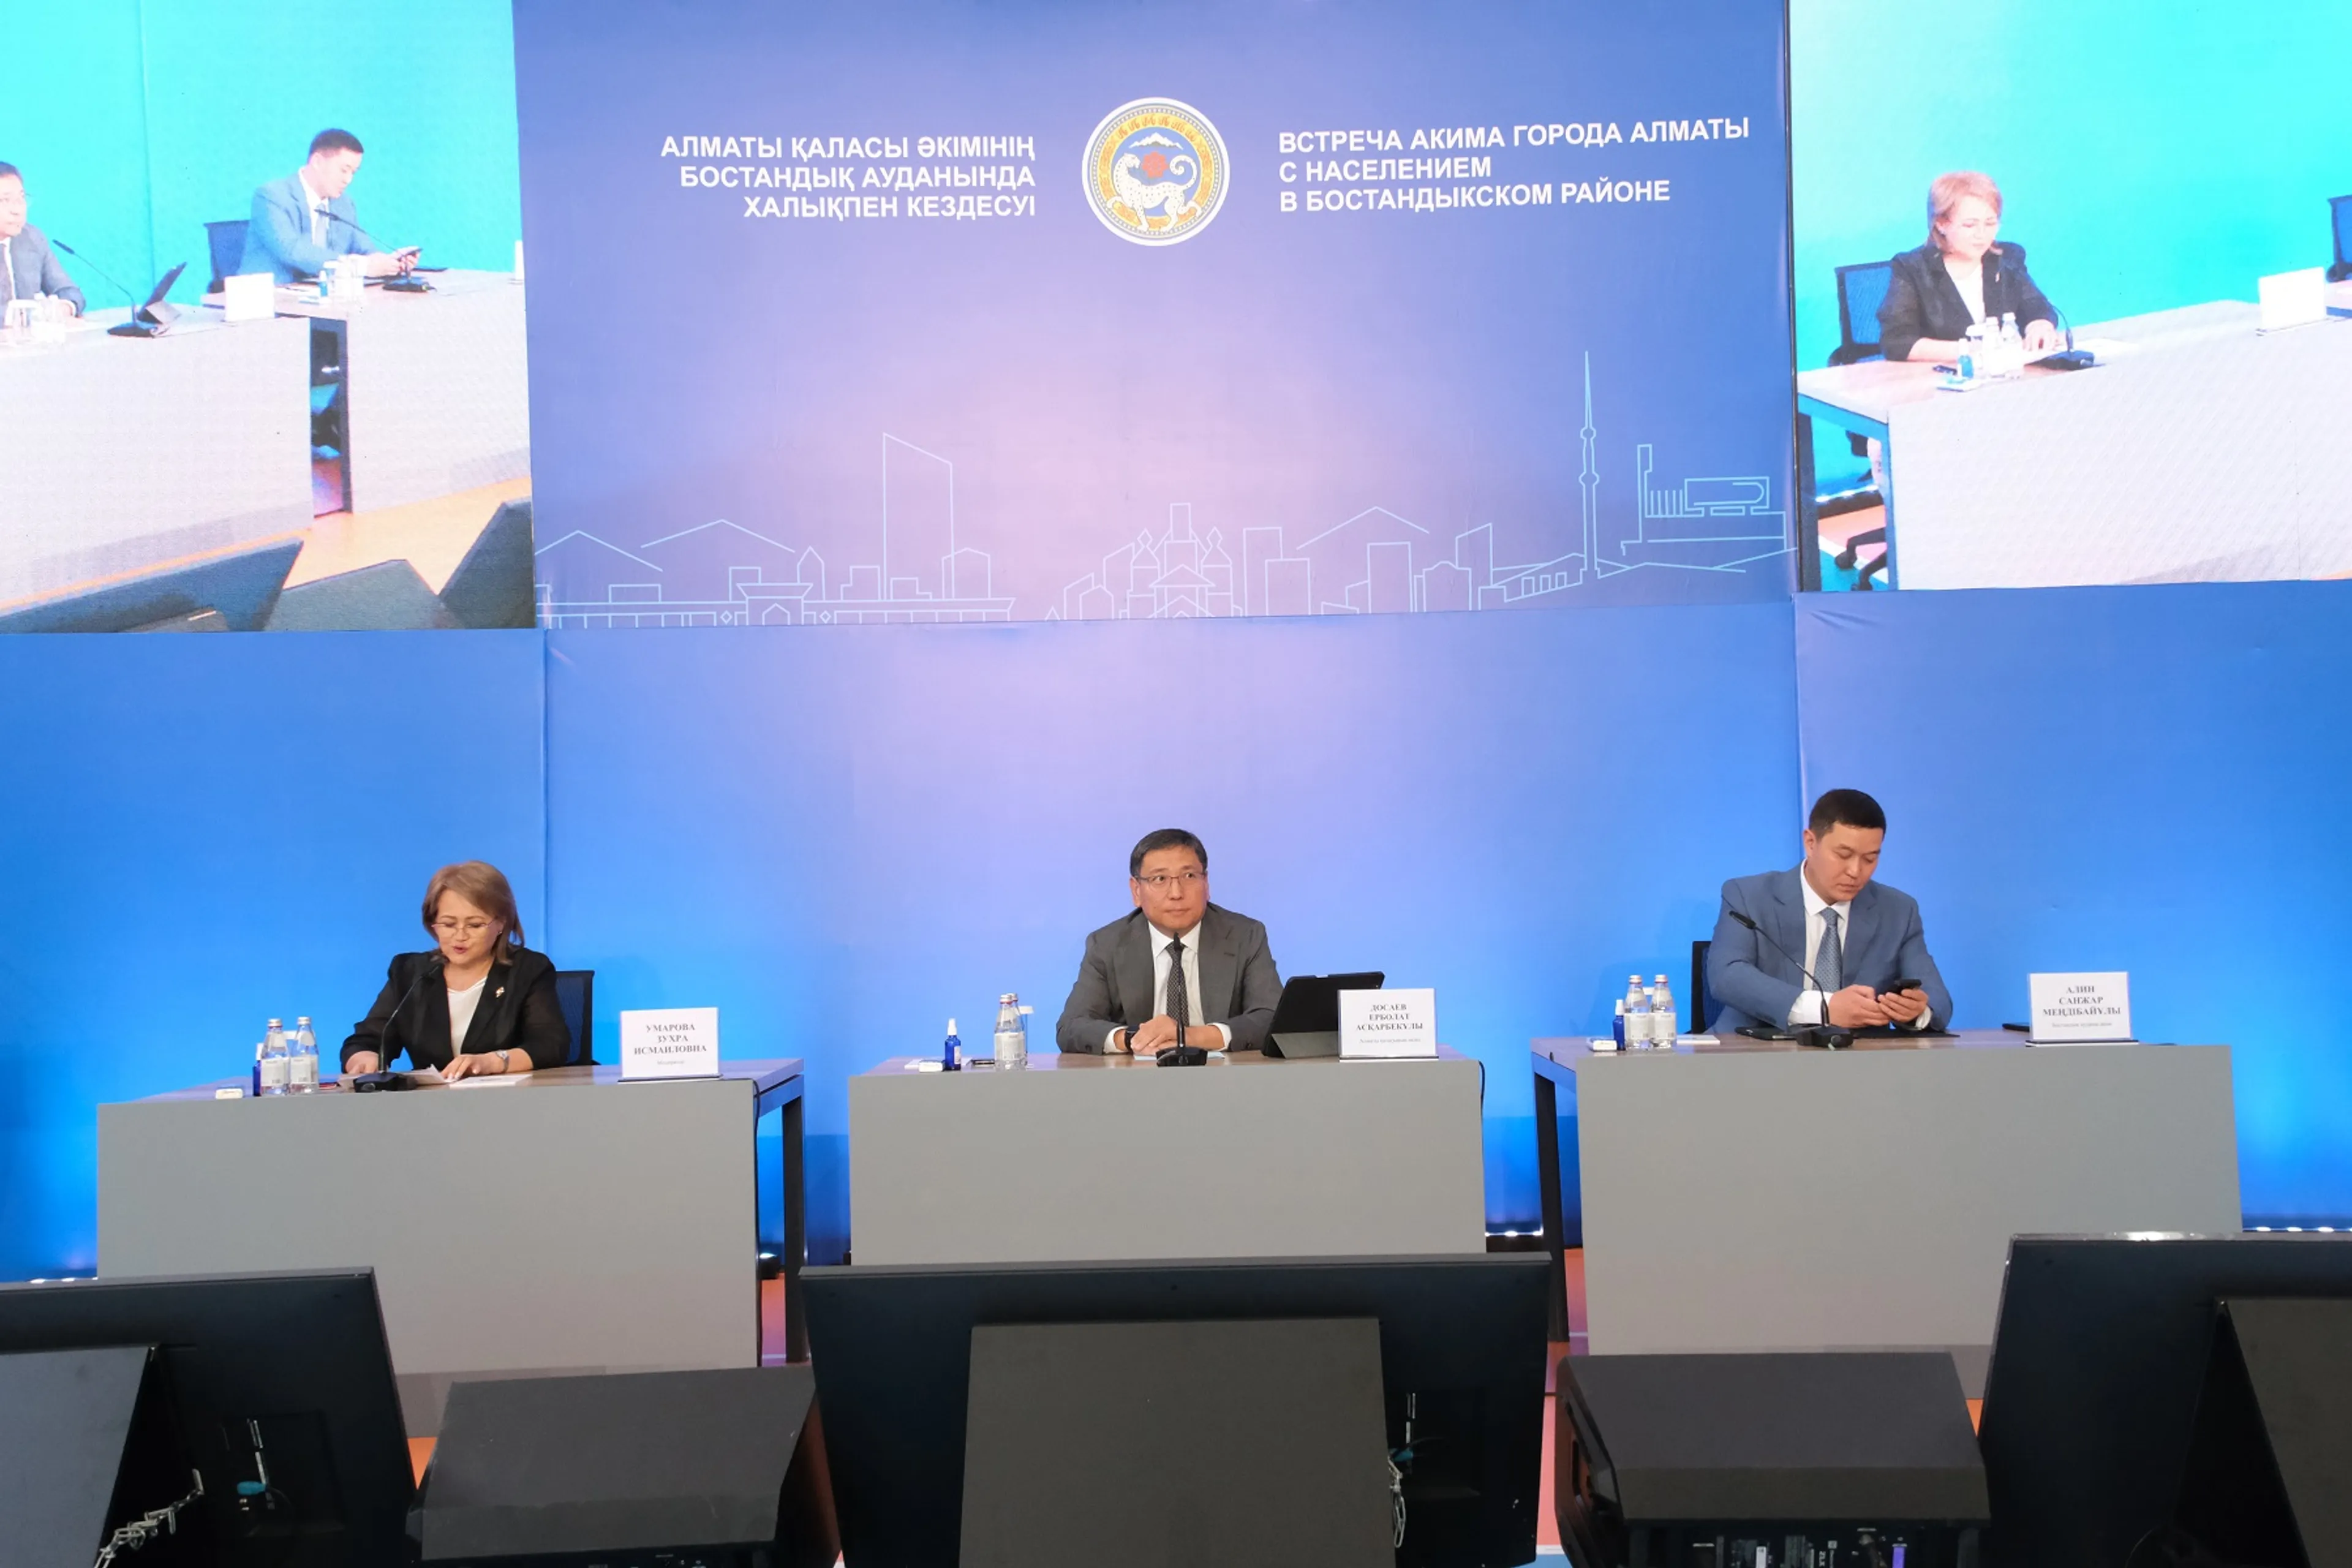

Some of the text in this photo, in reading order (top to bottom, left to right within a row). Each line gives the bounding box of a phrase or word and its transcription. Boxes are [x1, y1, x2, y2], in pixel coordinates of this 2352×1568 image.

[1280, 117, 1749, 153] ВСТРЕЧА АКИМА ГОРОДА АЛМАТЫ
[661, 136, 1035, 162] АЛМАТЫ ҚАЛАСЫ ӘКІМІНІҢ
[681, 166, 1035, 191] БОСТАНДЫҚ АУДАНЫНДА
[1280, 156, 1491, 182] С НАСЕЛЕНИЕМ
[1281, 176, 1670, 212] В БОСТАНДЫКСКОМ РАЙОНЕ
[744, 195, 1035, 221] ХАЛЫҚПЕН КЕЗДЕСУІ
[2059, 997, 2103, 1005] САНЖАР
[646, 1022, 695, 1033] УМАРОВА
[658, 1035, 688, 1044] ЗУХРА
[633, 1045, 707, 1055] ИСМАИЛОВНА
